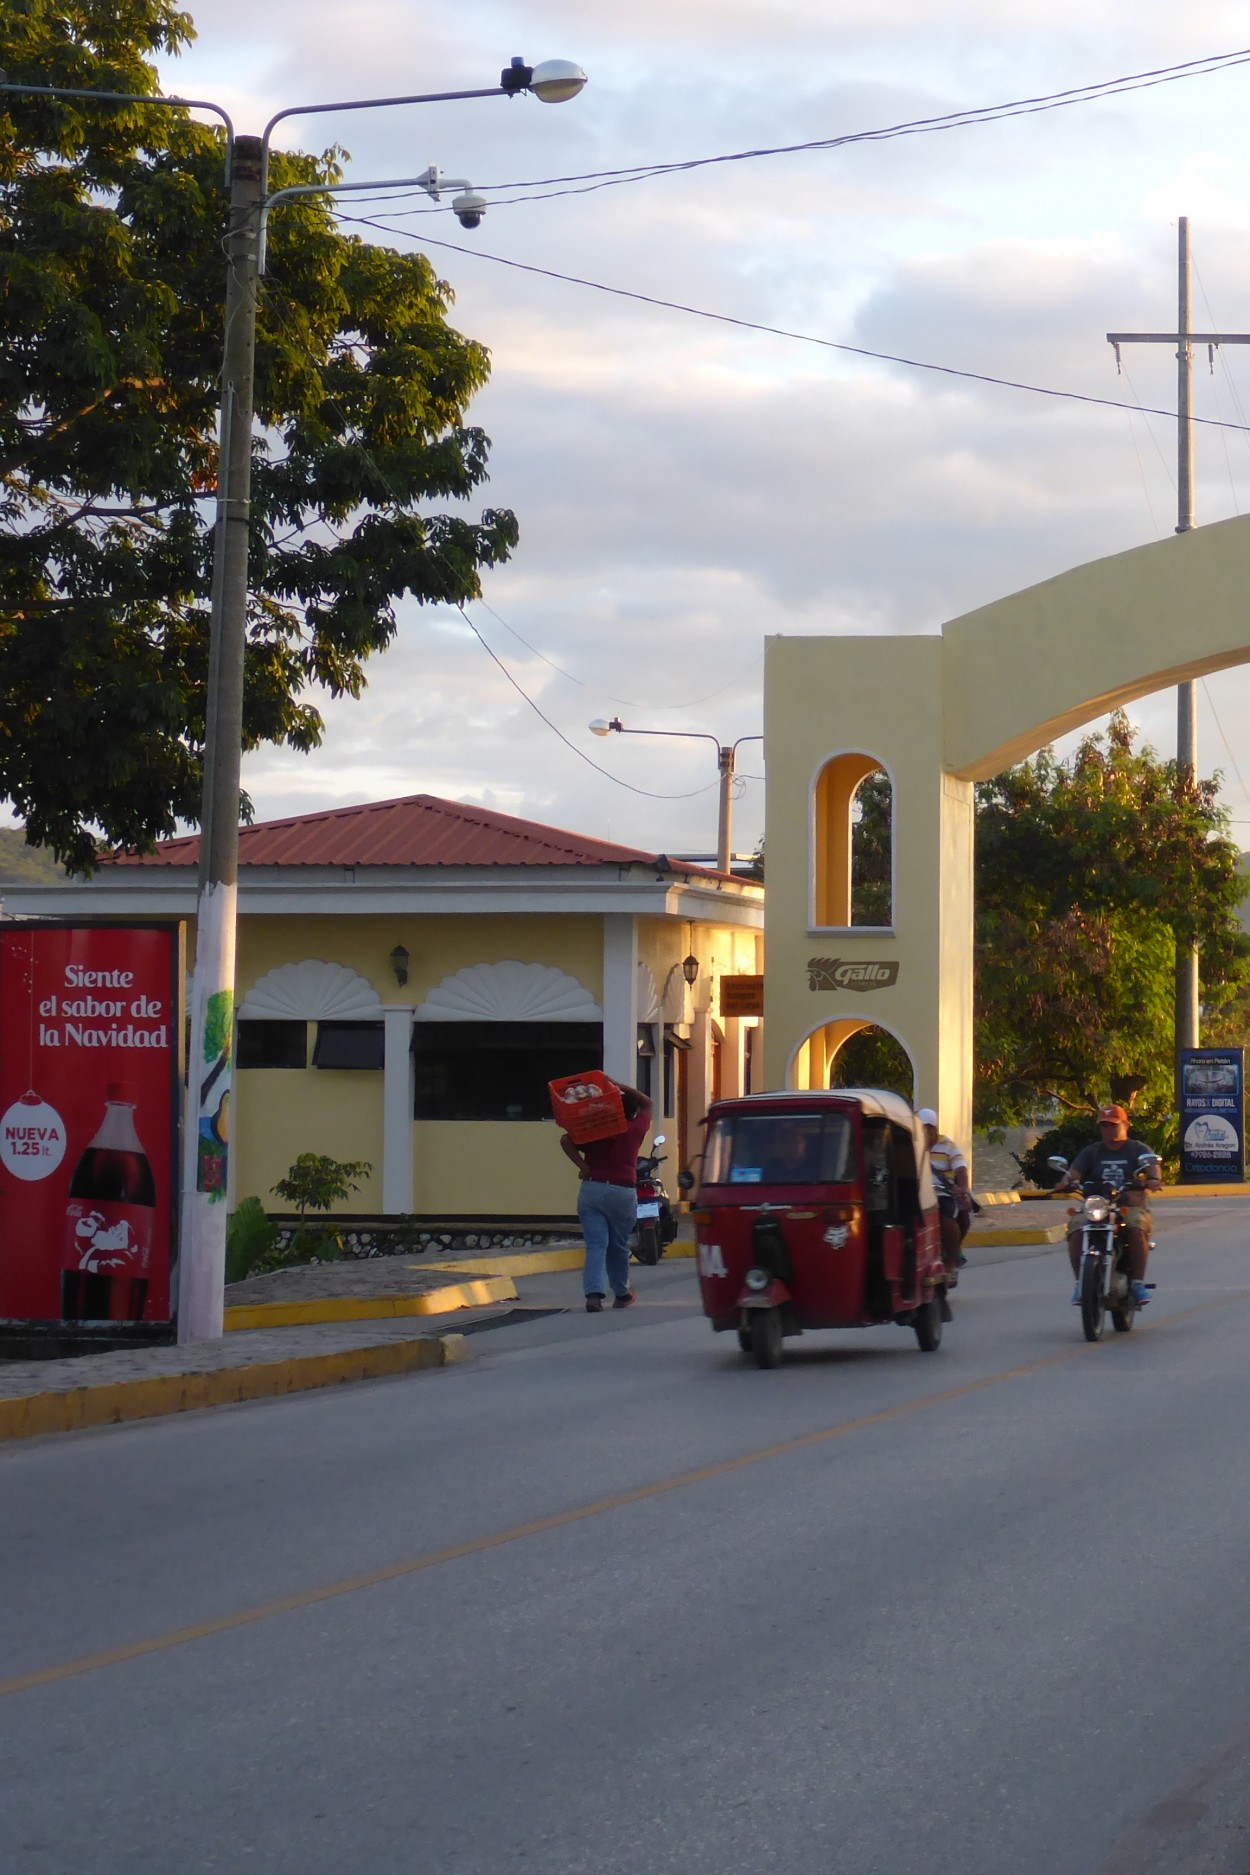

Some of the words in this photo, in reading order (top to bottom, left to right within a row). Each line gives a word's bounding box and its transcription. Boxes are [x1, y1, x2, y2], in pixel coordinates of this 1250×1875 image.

[64, 965, 134, 988] Siente
[39, 995, 57, 1017] el
[61, 995, 126, 1017] sabor
[131, 995, 162, 1018] de
[39, 1023, 60, 1046] la
[65, 1023, 168, 1048] Navidad
[1186, 1098, 1206, 1107] RAYOS
[1211, 1098, 1235, 1107] DIGITAL
[5, 1127, 59, 1141] NUEVA
[10, 1141, 40, 1156] 1.25
